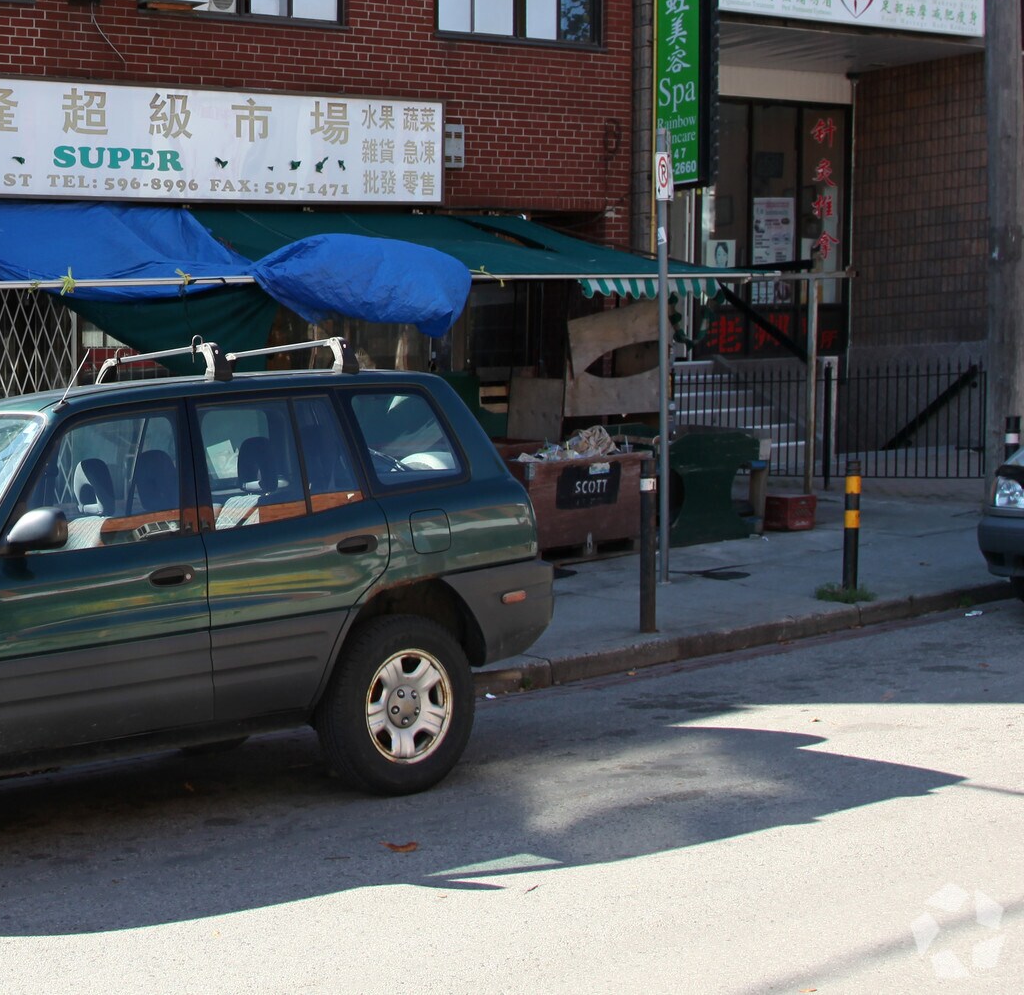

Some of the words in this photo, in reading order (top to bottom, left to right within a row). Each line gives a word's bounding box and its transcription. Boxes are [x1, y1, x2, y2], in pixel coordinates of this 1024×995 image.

[658, 77, 696, 112] Spa
[361, 104, 395, 130] 水果
[402, 106, 436, 133] 蔬菜
[657, 114, 697, 131] Rainbow
[52, 144, 184, 172] SUPER
[361, 137, 395, 165] 雜貨
[402, 139, 436, 165] 急凍
[3, 173, 33, 188] ST
[47, 173, 98, 190] TEL:
[104, 177, 199, 193] 596-8996
[209, 178, 259, 195] FAX:
[264, 181, 350, 197] 597-1471
[363, 169, 397, 195] 批發
[402, 170, 436, 197] 零售
[574, 479, 608, 494] SCOTT
